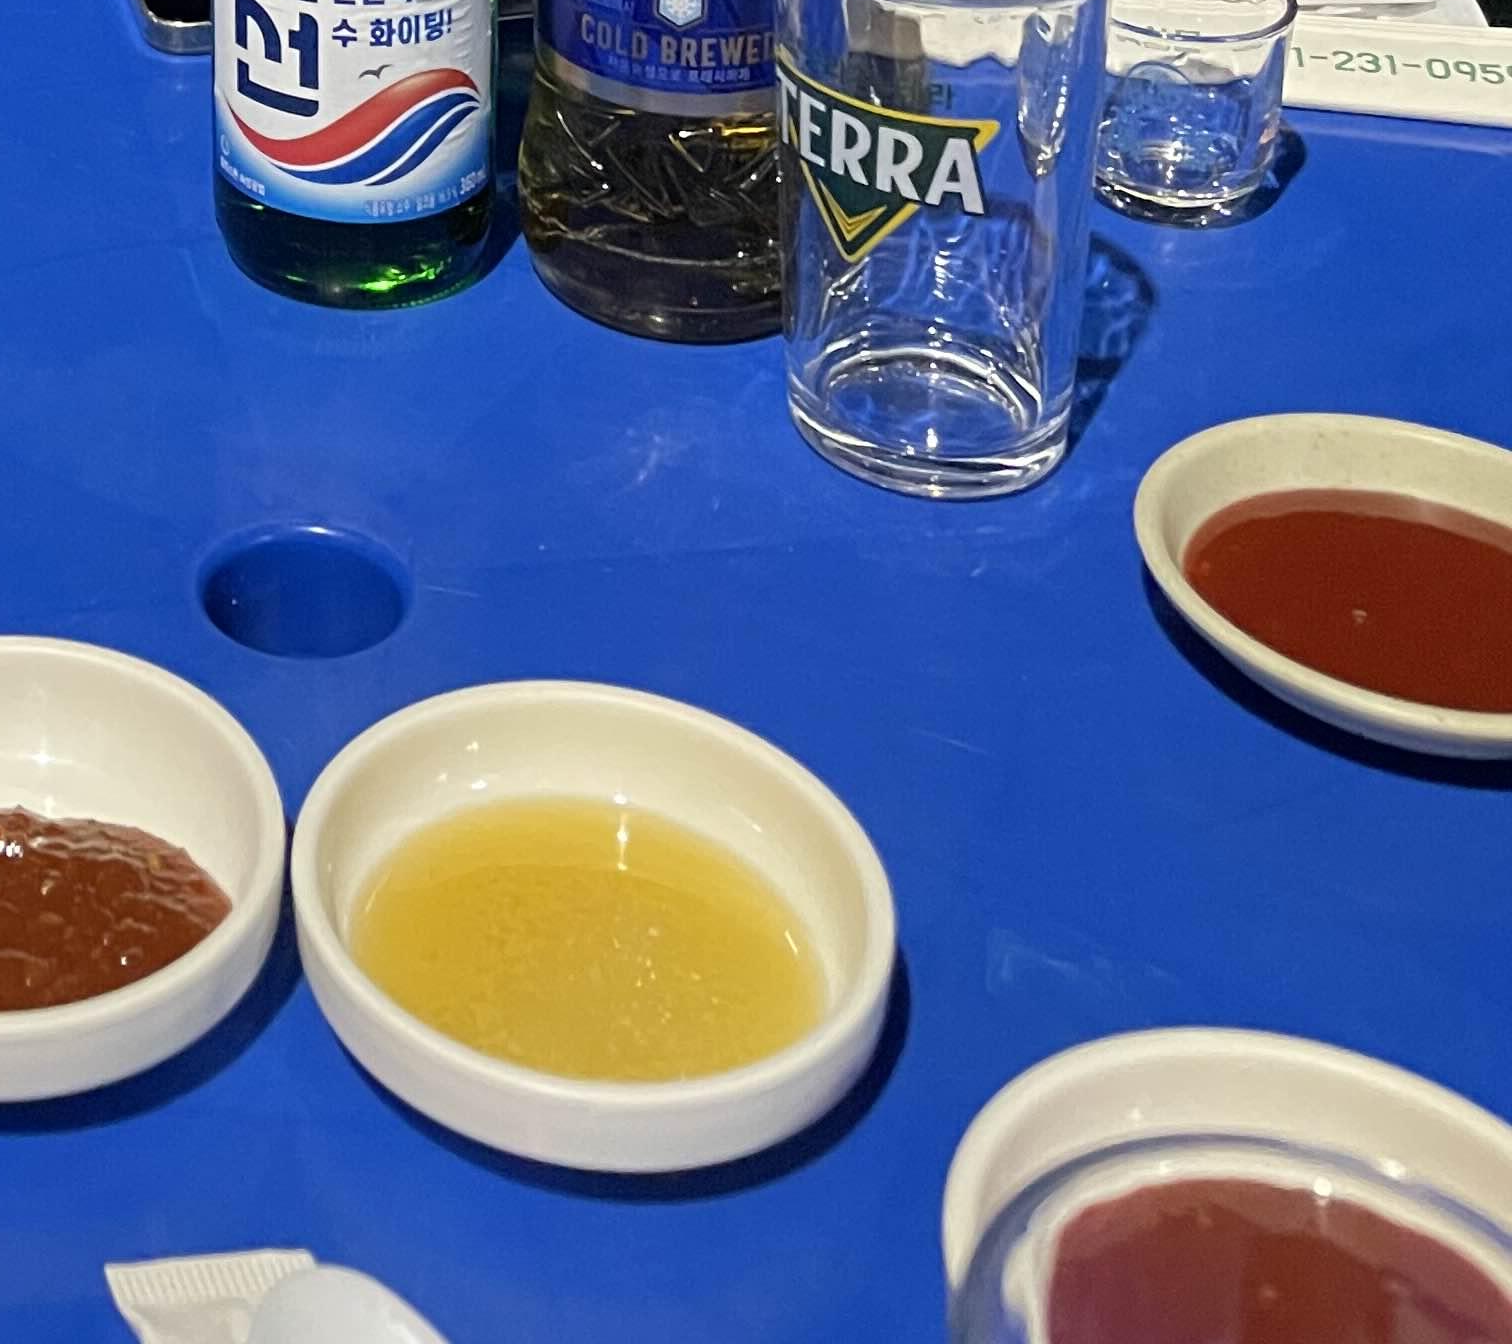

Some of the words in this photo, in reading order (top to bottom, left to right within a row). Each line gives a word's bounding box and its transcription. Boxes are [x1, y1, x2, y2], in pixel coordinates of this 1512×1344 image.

[331, 18, 358, 49] 수
[368, 7, 453, 49] 화이팅!
[580, 13, 648, 61] COLD
[777, 69, 985, 215] TERRA
